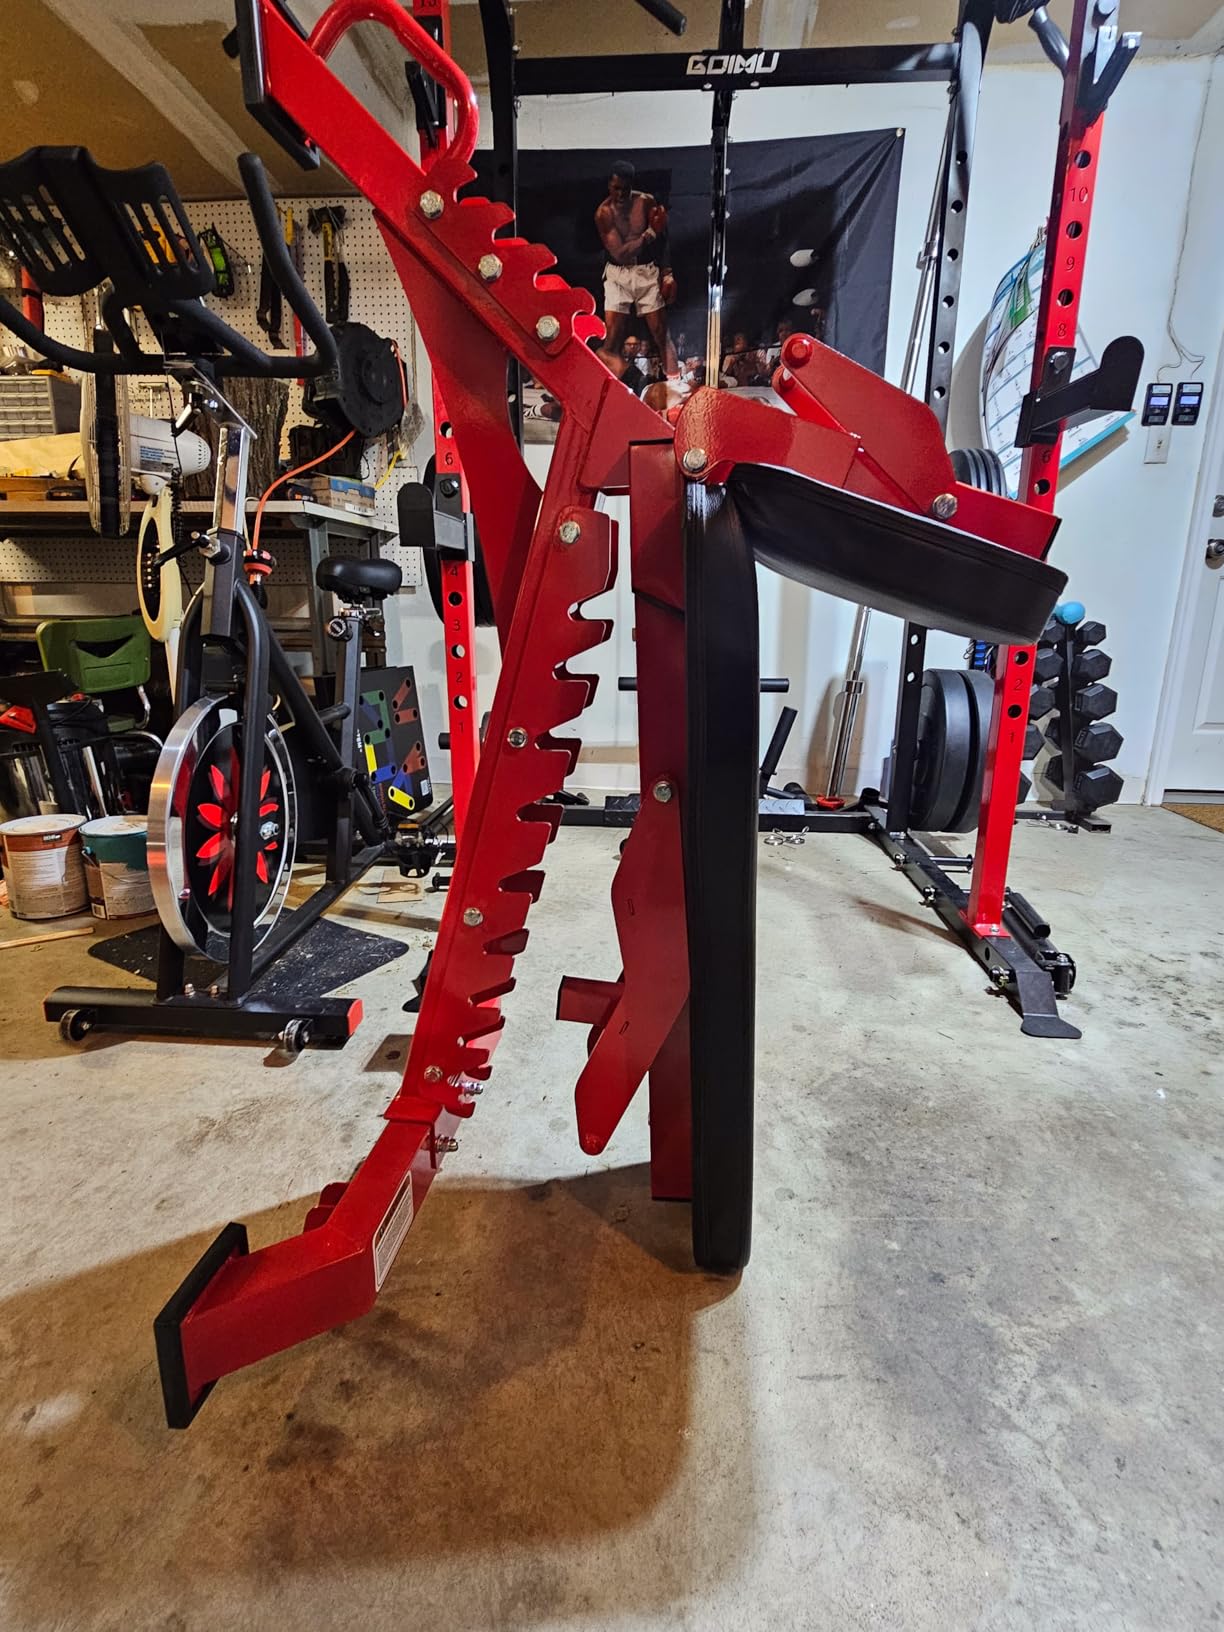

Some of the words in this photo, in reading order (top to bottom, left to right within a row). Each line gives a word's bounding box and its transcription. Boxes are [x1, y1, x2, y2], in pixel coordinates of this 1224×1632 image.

[686, 52, 780, 75] GOIMU
[1070, 187, 1089, 202] 10
[1065, 255, 1075, 271] 9
[1057, 322, 1067, 337] 8
[445, 452, 454, 466] 6
[1041, 449, 1051, 464] 6
[448, 565, 459, 577] 4
[453, 619, 461, 632] 3
[456, 671, 463, 684] 2
[1013, 679, 1024, 691] 2
[458, 722, 465, 735] 1
[1009, 730, 1016, 744] 1
